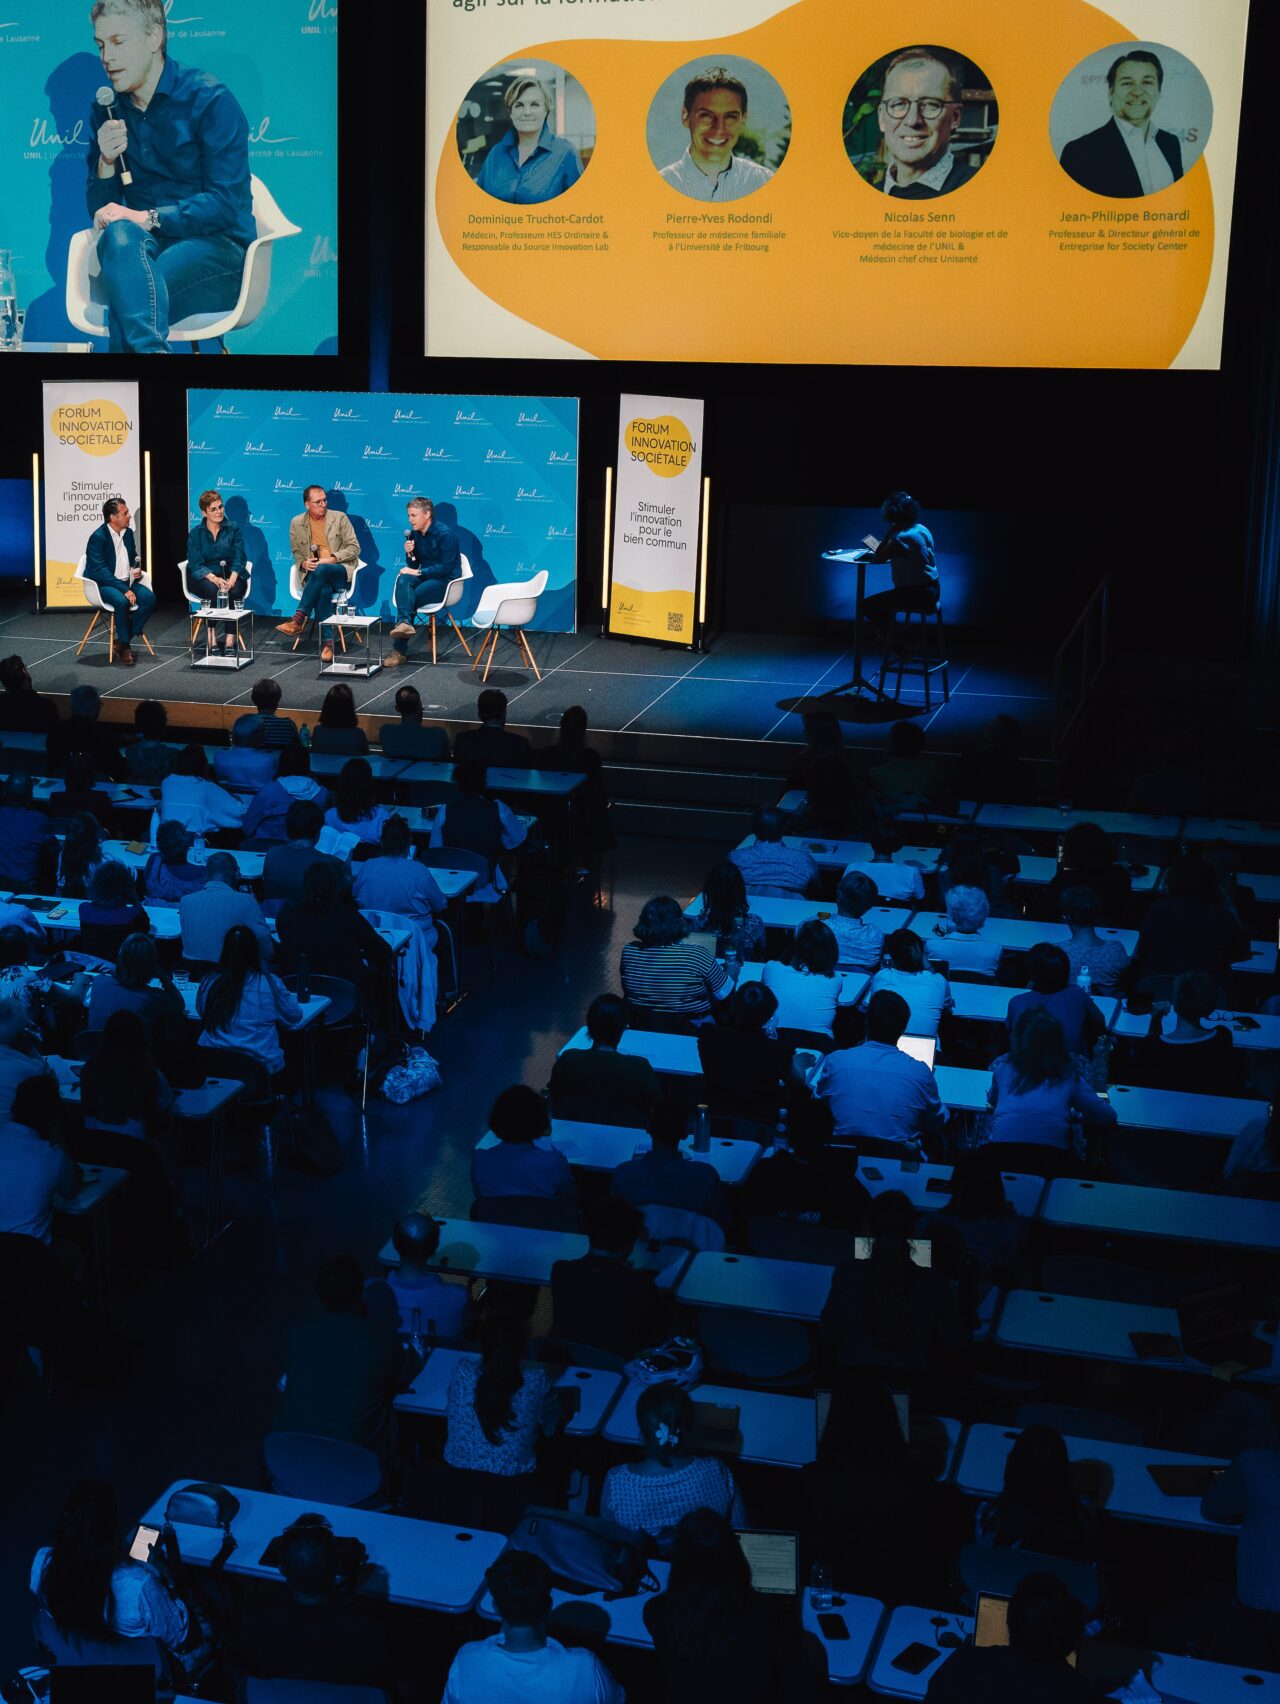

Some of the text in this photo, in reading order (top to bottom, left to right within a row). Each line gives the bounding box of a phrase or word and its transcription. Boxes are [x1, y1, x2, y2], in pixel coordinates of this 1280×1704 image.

[30, 118, 90, 147] Unil
[468, 213, 604, 226] Dominique Truchot-Cardot
[666, 213, 773, 224] Pierre-Yves Rodondi
[884, 212, 956, 222] Nicolas Senn
[1060, 210, 1190, 224] Jean-Philippe Bonardi
[462, 231, 609, 240] Médecin, Professeure HES Ordinaire &
[653, 231, 694, 239] Professeur
[697, 231, 707, 239] de
[710, 231, 749, 239] médecine
[832, 230, 878, 240] Vice-doyen
[881, 230, 891, 238] de
[894, 230, 901, 238] la
[936, 230, 947, 238] de
[949, 230, 983, 240] biologie
[986, 230, 995, 238] et
[997, 230, 1008, 238] de
[1048, 230, 1095, 238] Professeur
[1108, 230, 1149, 238] Directeur
[1152, 229, 1186, 239] général
[1189, 229, 1200, 237] de
[462, 243, 510, 252] Responsable
[512, 243, 521, 251] du
[524, 243, 550, 251] Source
[595, 243, 609, 251] Lab
[723, 243, 733, 251] de
[735, 243, 769, 252] Fribourg
[873, 242, 914, 251] médecine
[917, 242, 927, 251] de
[1059, 242, 1188, 251] Entreprise for Society Center
[859, 255, 978, 263] Médecin chef chez Unisanté
[59, 408, 101, 418] FORUM
[59, 421, 133, 431] INNOVATION
[632, 422, 670, 435] FORUM
[59, 433, 124, 445] SOCIÉTALE
[631, 436, 696, 453] INNOVATION
[631, 450, 687, 467] SOCIÉTALE
[71, 481, 114, 491] Stimuler
[63, 492, 122, 501] l'innovation
[74, 503, 99, 513] pour
[638, 501, 676, 516] Stimuler
[57, 512, 79, 522] bien
[630, 512, 682, 527] l'innovation
[639, 525, 672, 538] pour le
[624, 533, 687, 551] bien commun
